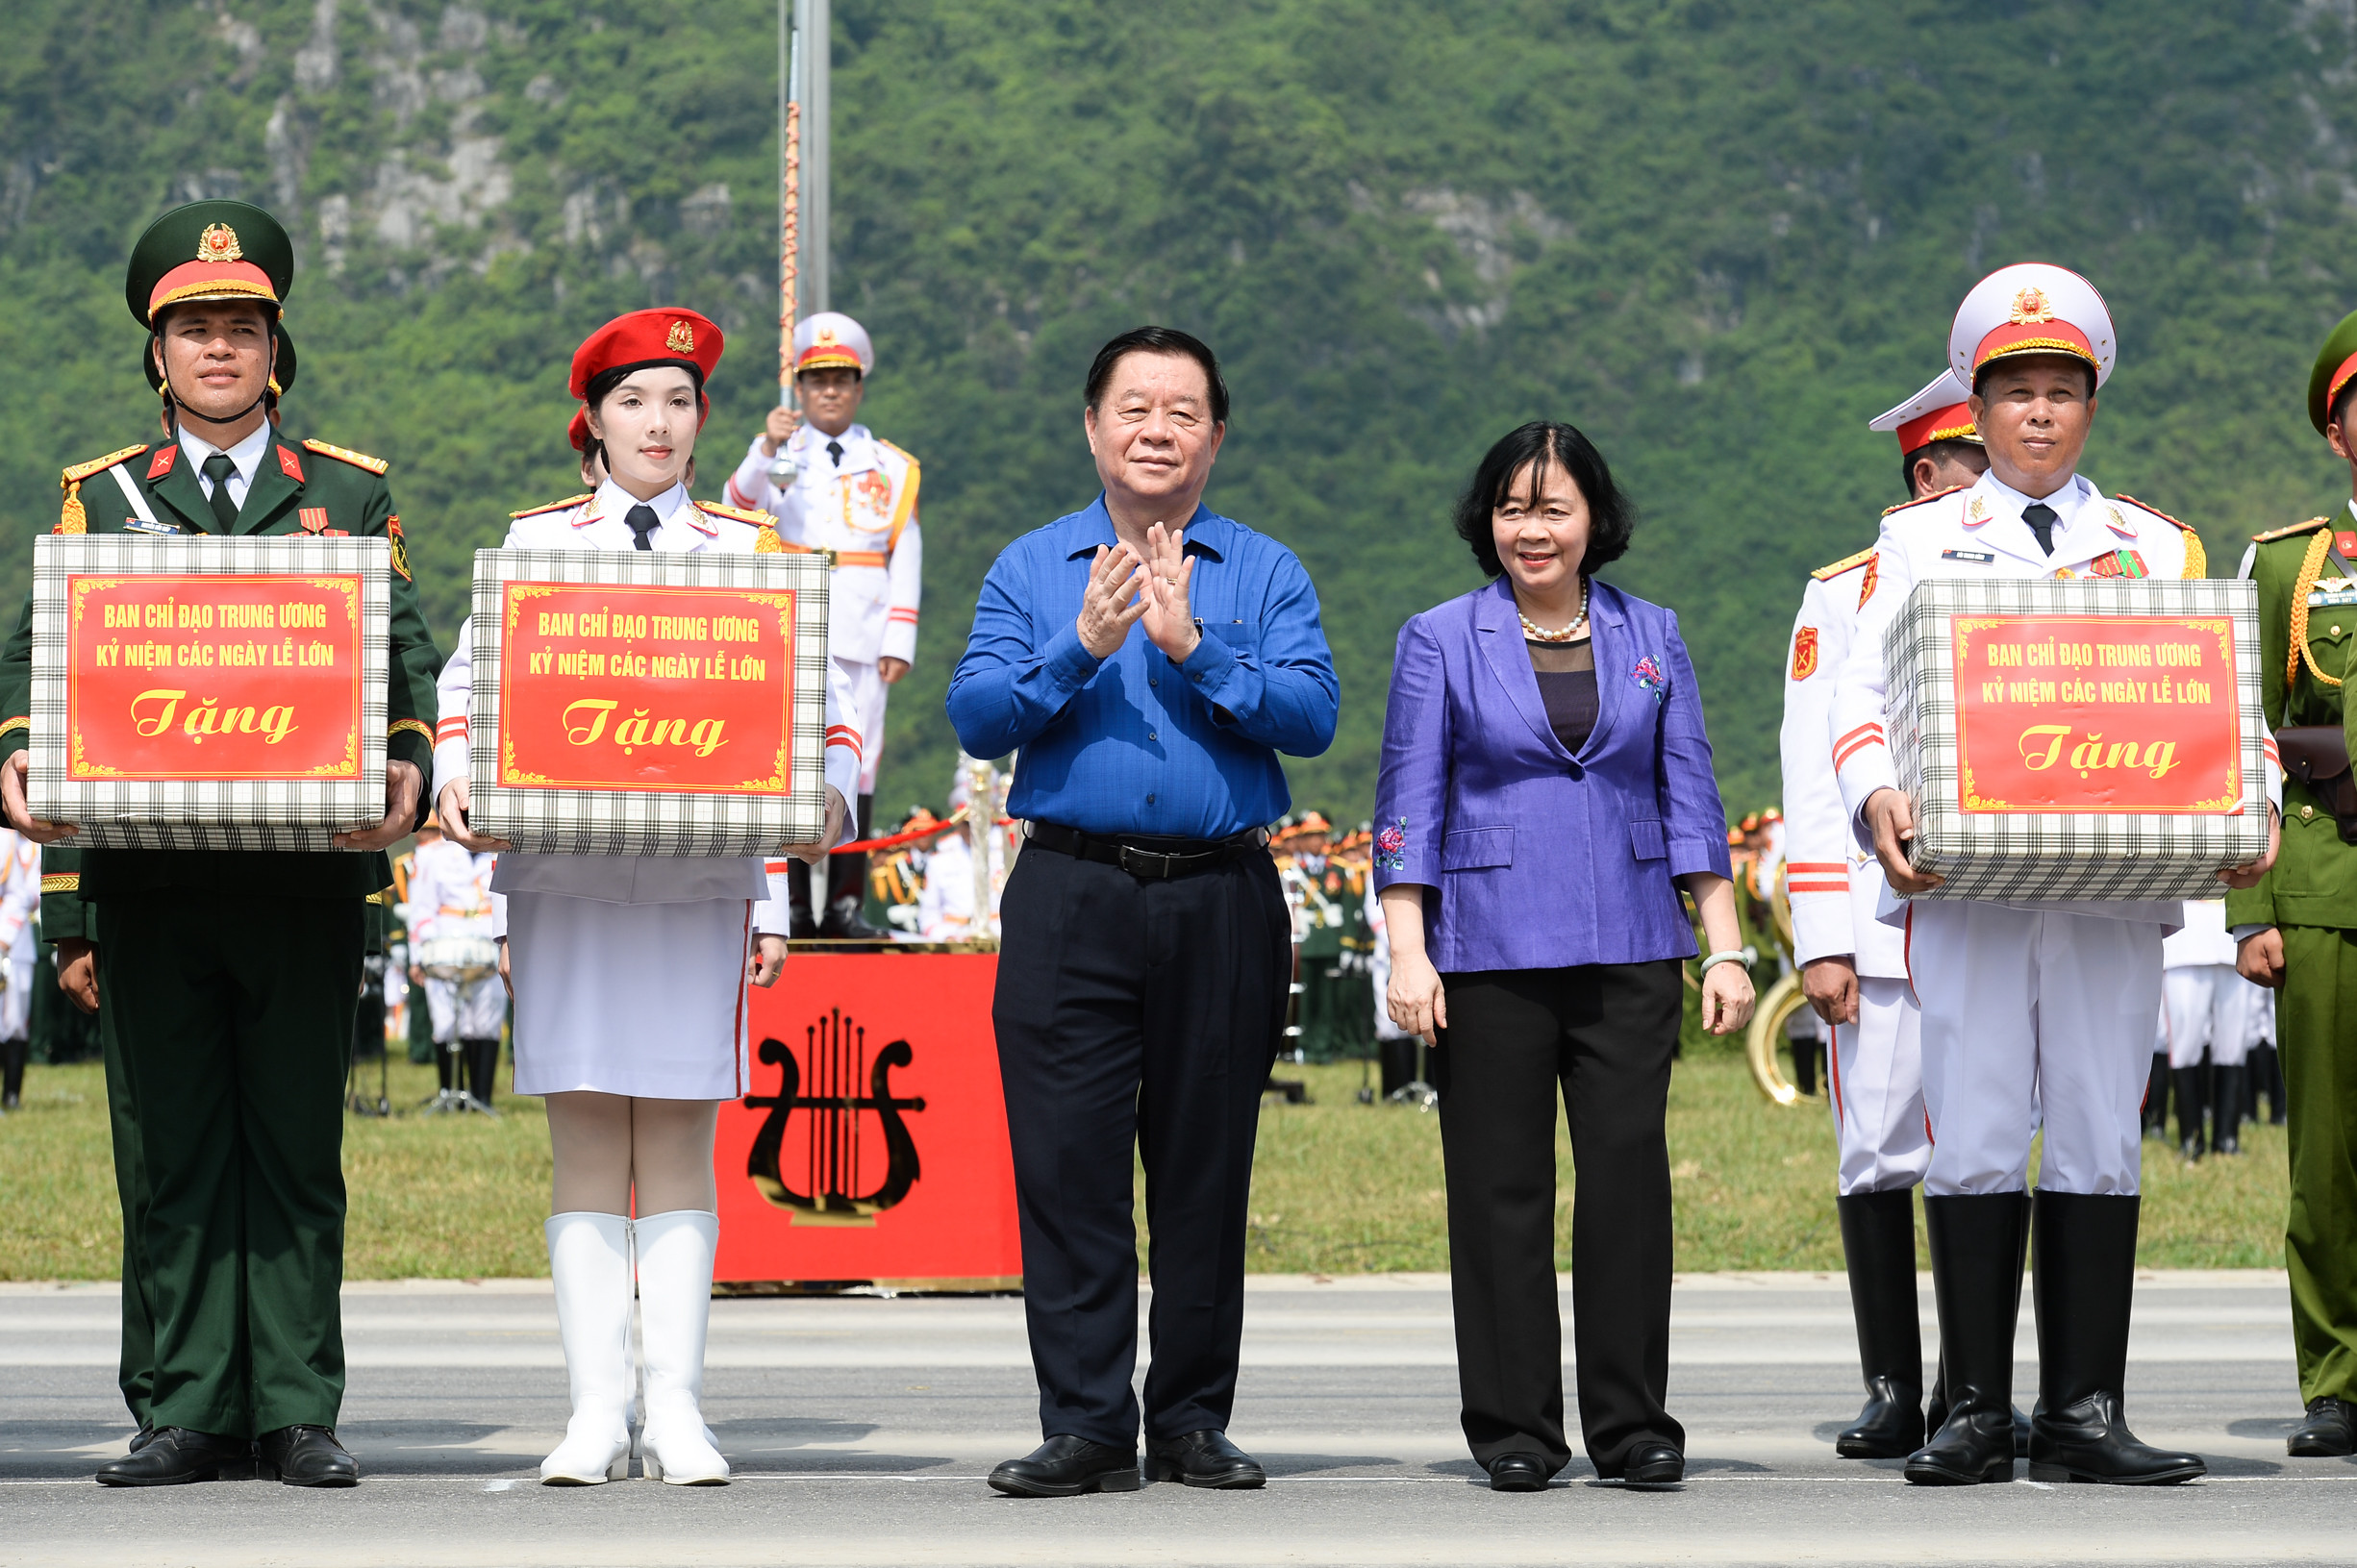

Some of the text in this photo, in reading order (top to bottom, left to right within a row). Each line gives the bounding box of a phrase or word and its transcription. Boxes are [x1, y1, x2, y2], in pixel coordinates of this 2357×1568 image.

[104, 597, 326, 634] BAN CHỈ ĐẠO TRUNG ƯƠNG
[539, 606, 759, 643] BAN CHỈ ĐẠO TRUNG ƯƠNG
[96, 637, 334, 671] KỶ NIỆM CÁC NGÀY LỄ LỚN
[530, 646, 765, 681] KỶ NIỆM CÁC NGÀY LỄ LỚN
[1988, 636, 2201, 671] BAN CHỈ ĐẠO TRUNG ƯƠNG
[1982, 675, 2211, 707] KỶ NIỆM CÁC NGÀY LỄ LỚN
[131, 689, 299, 744] Tặng
[562, 699, 729, 757] Tặng
[2018, 725, 2180, 779] Tặng
